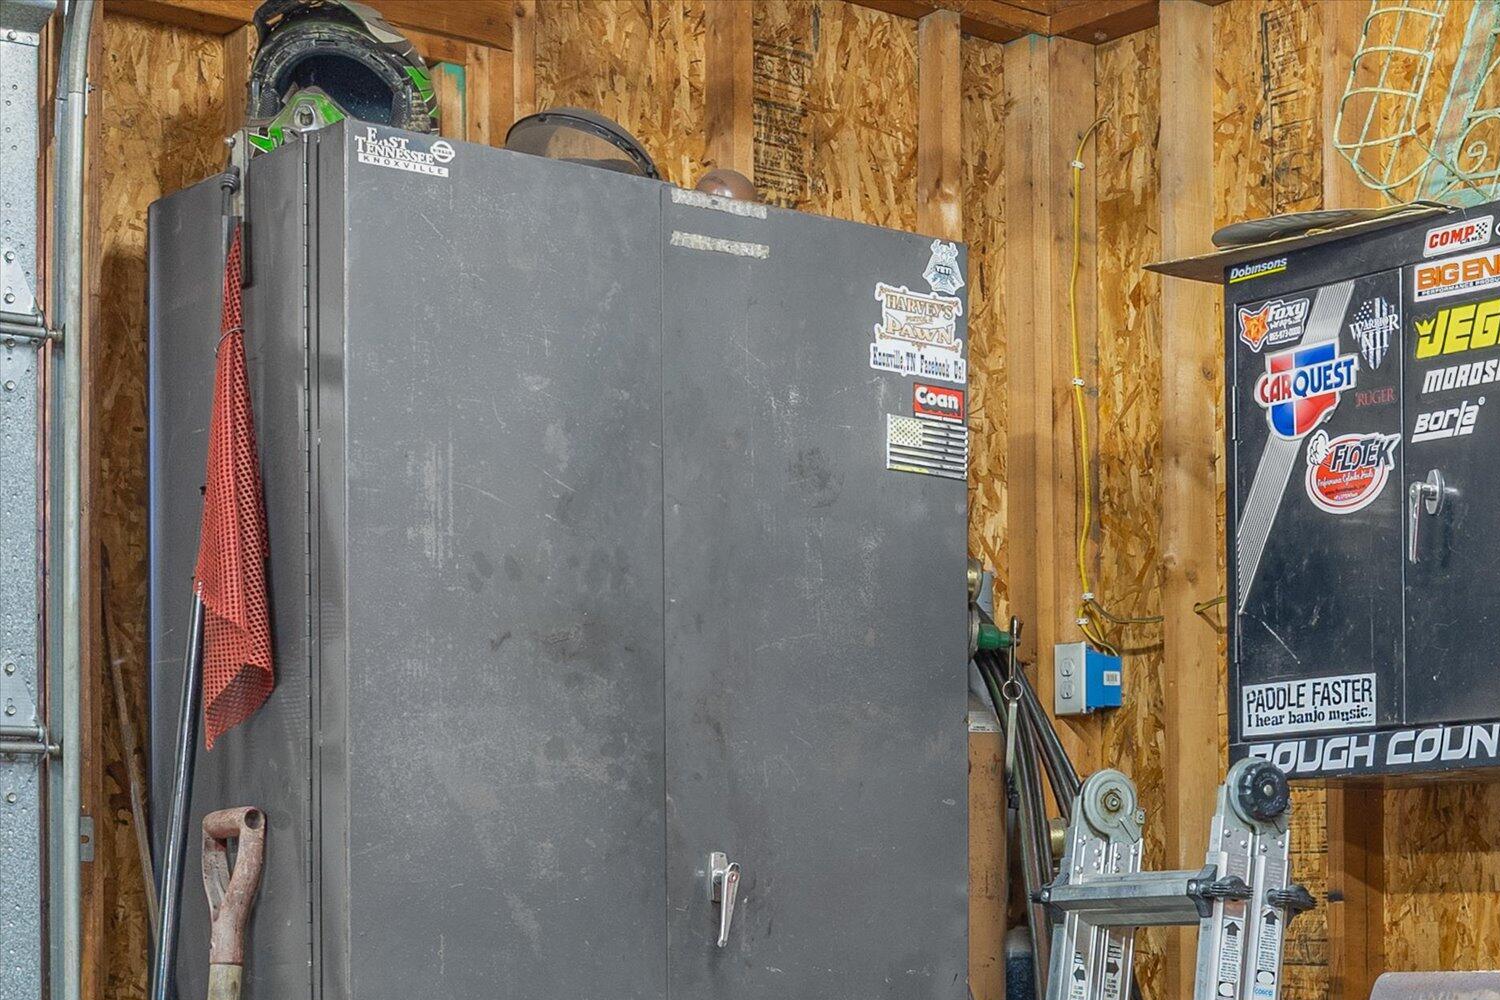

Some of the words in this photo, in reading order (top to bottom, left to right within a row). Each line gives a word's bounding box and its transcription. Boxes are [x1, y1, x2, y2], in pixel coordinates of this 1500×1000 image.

[354, 135, 435, 166] TENNESSEE
[366, 126, 409, 150] EAST
[363, 155, 444, 175] KNOXVILLE
[1429, 225, 1476, 249] COMP
[1230, 257, 1288, 280] Dobinsons
[1417, 262, 1461, 291] BIG
[886, 294, 954, 320] HARVEY'S
[1268, 301, 1307, 321] Foxy
[885, 312, 955, 346] PAWN
[1260, 360, 1355, 403] CARQUEST
[914, 386, 960, 410] Coan
[1330, 438, 1396, 471] FLOTEK
[1246, 683, 1307, 714] PADDLE
[1311, 677, 1373, 707] FASTER
[1247, 714, 1252, 727] I
[1255, 713, 1285, 727] hear
[1288, 706, 1325, 725] banjo
[1328, 705, 1373, 721] music.
